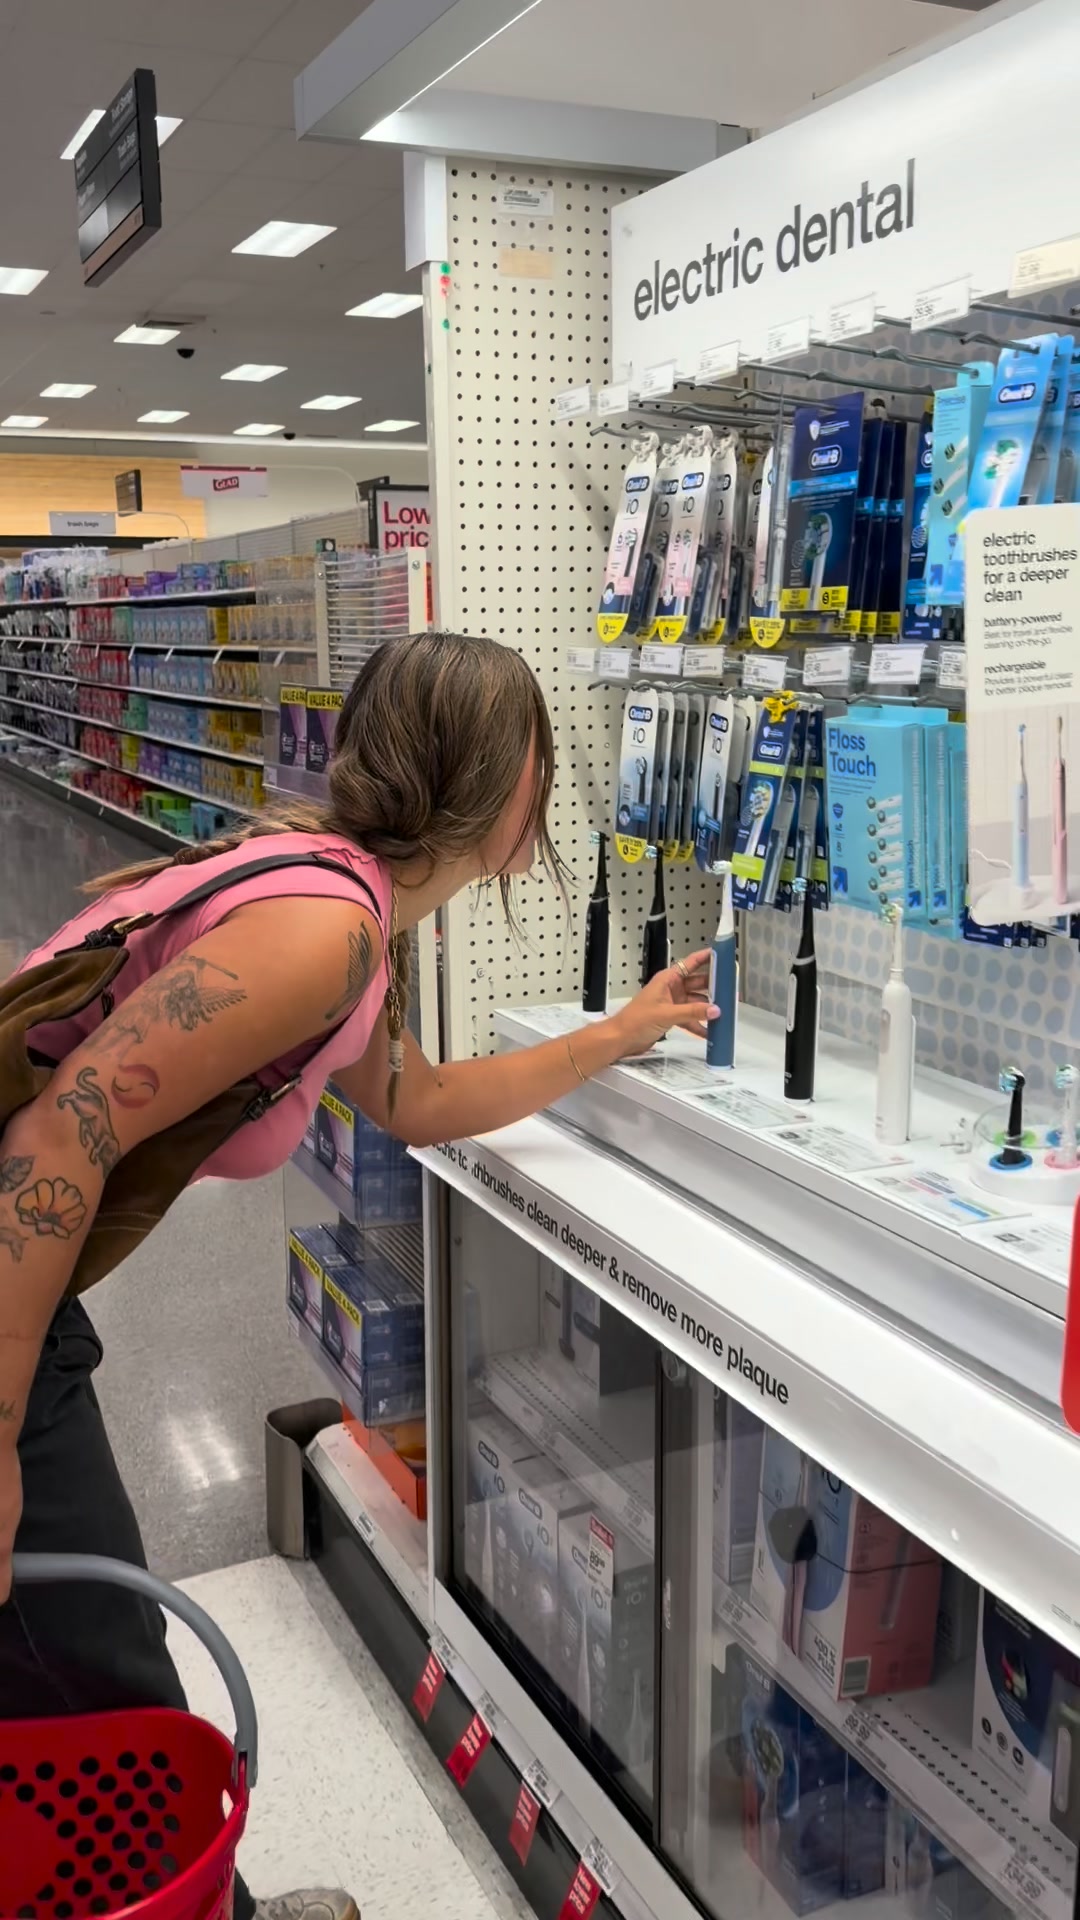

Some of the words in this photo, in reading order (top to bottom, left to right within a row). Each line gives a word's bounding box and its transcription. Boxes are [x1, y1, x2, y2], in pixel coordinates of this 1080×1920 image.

[634, 227, 764, 321] electric
[776, 158, 916, 273] dental
[215, 476, 238, 489] GLAD
[384, 501, 430, 525] Low
[385, 525, 429, 553] pric
[983, 532, 1036, 547] electric
[984, 549, 1078, 566] toothbrushes
[984, 571, 1003, 585] for
[1007, 572, 1016, 583] a
[1020, 568, 1069, 584] deeper
[984, 588, 1022, 603] clean
[633, 728, 646, 743] iO
[828, 728, 867, 751] Floss
[830, 752, 877, 777] Touch
[527, 1200, 558, 1238] clean
[561, 1223, 607, 1271] deeper
[609, 1257, 620, 1283] &
[622, 1269, 678, 1323] remove
[681, 1312, 723, 1357] more
[727, 1344, 789, 1405] plaque
